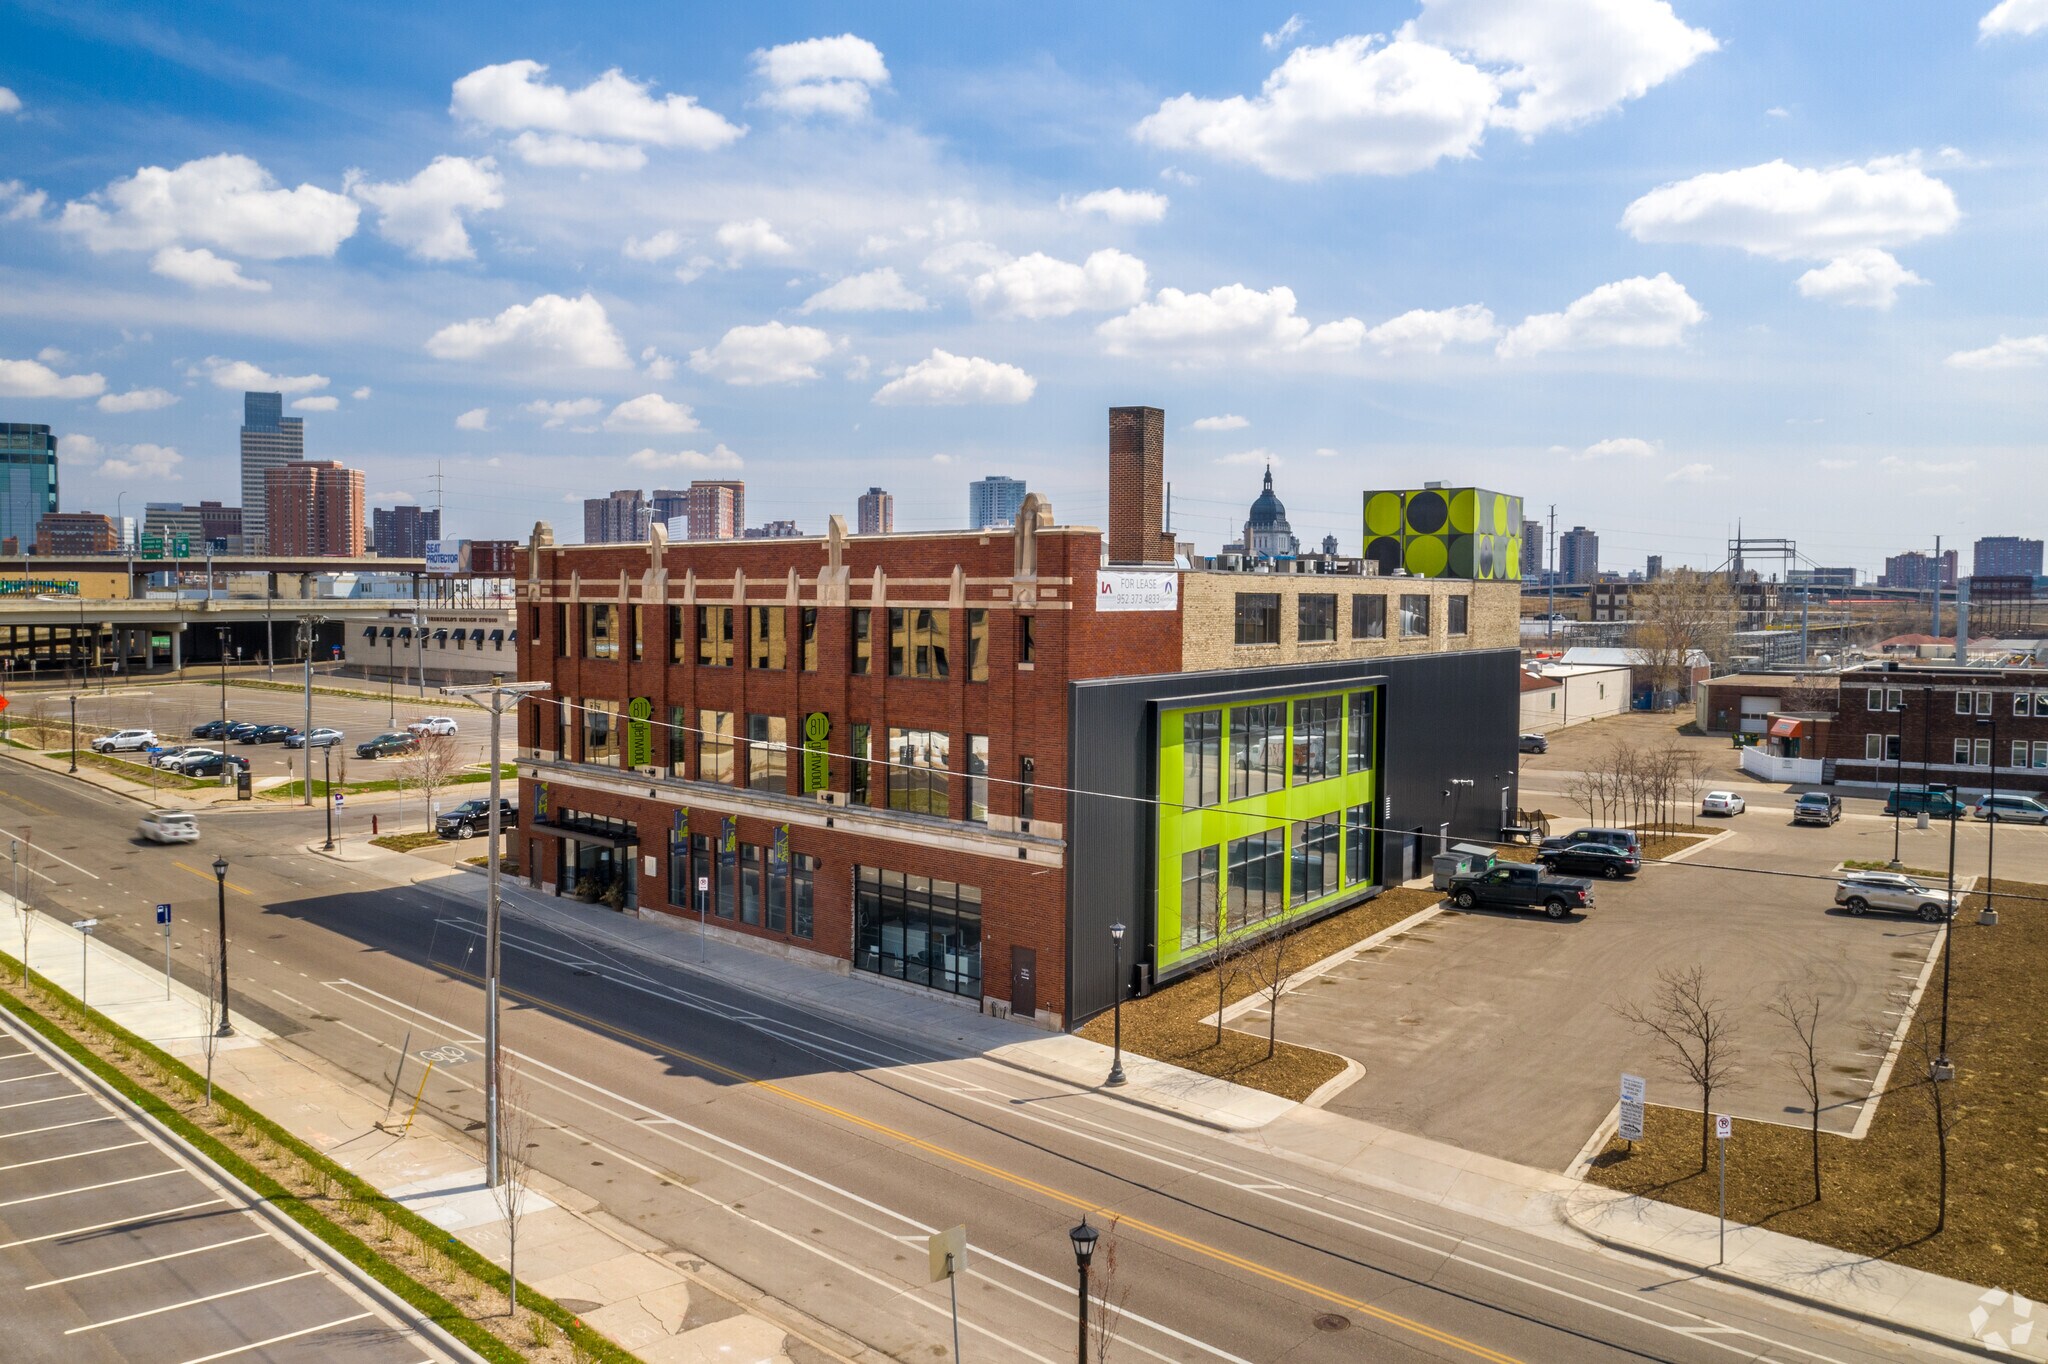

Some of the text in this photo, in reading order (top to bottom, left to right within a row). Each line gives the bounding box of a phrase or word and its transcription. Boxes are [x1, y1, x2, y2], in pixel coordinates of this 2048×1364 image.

[426, 543, 441, 554] SEAT
[426, 554, 458, 564] PROTECTOR
[1121, 578, 1157, 589] FOR LEASE
[1117, 594, 1160, 604] 952 373 4833
[633, 702, 648, 718] 811
[810, 718, 826, 735] 811
[631, 722, 649, 765] glenwood
